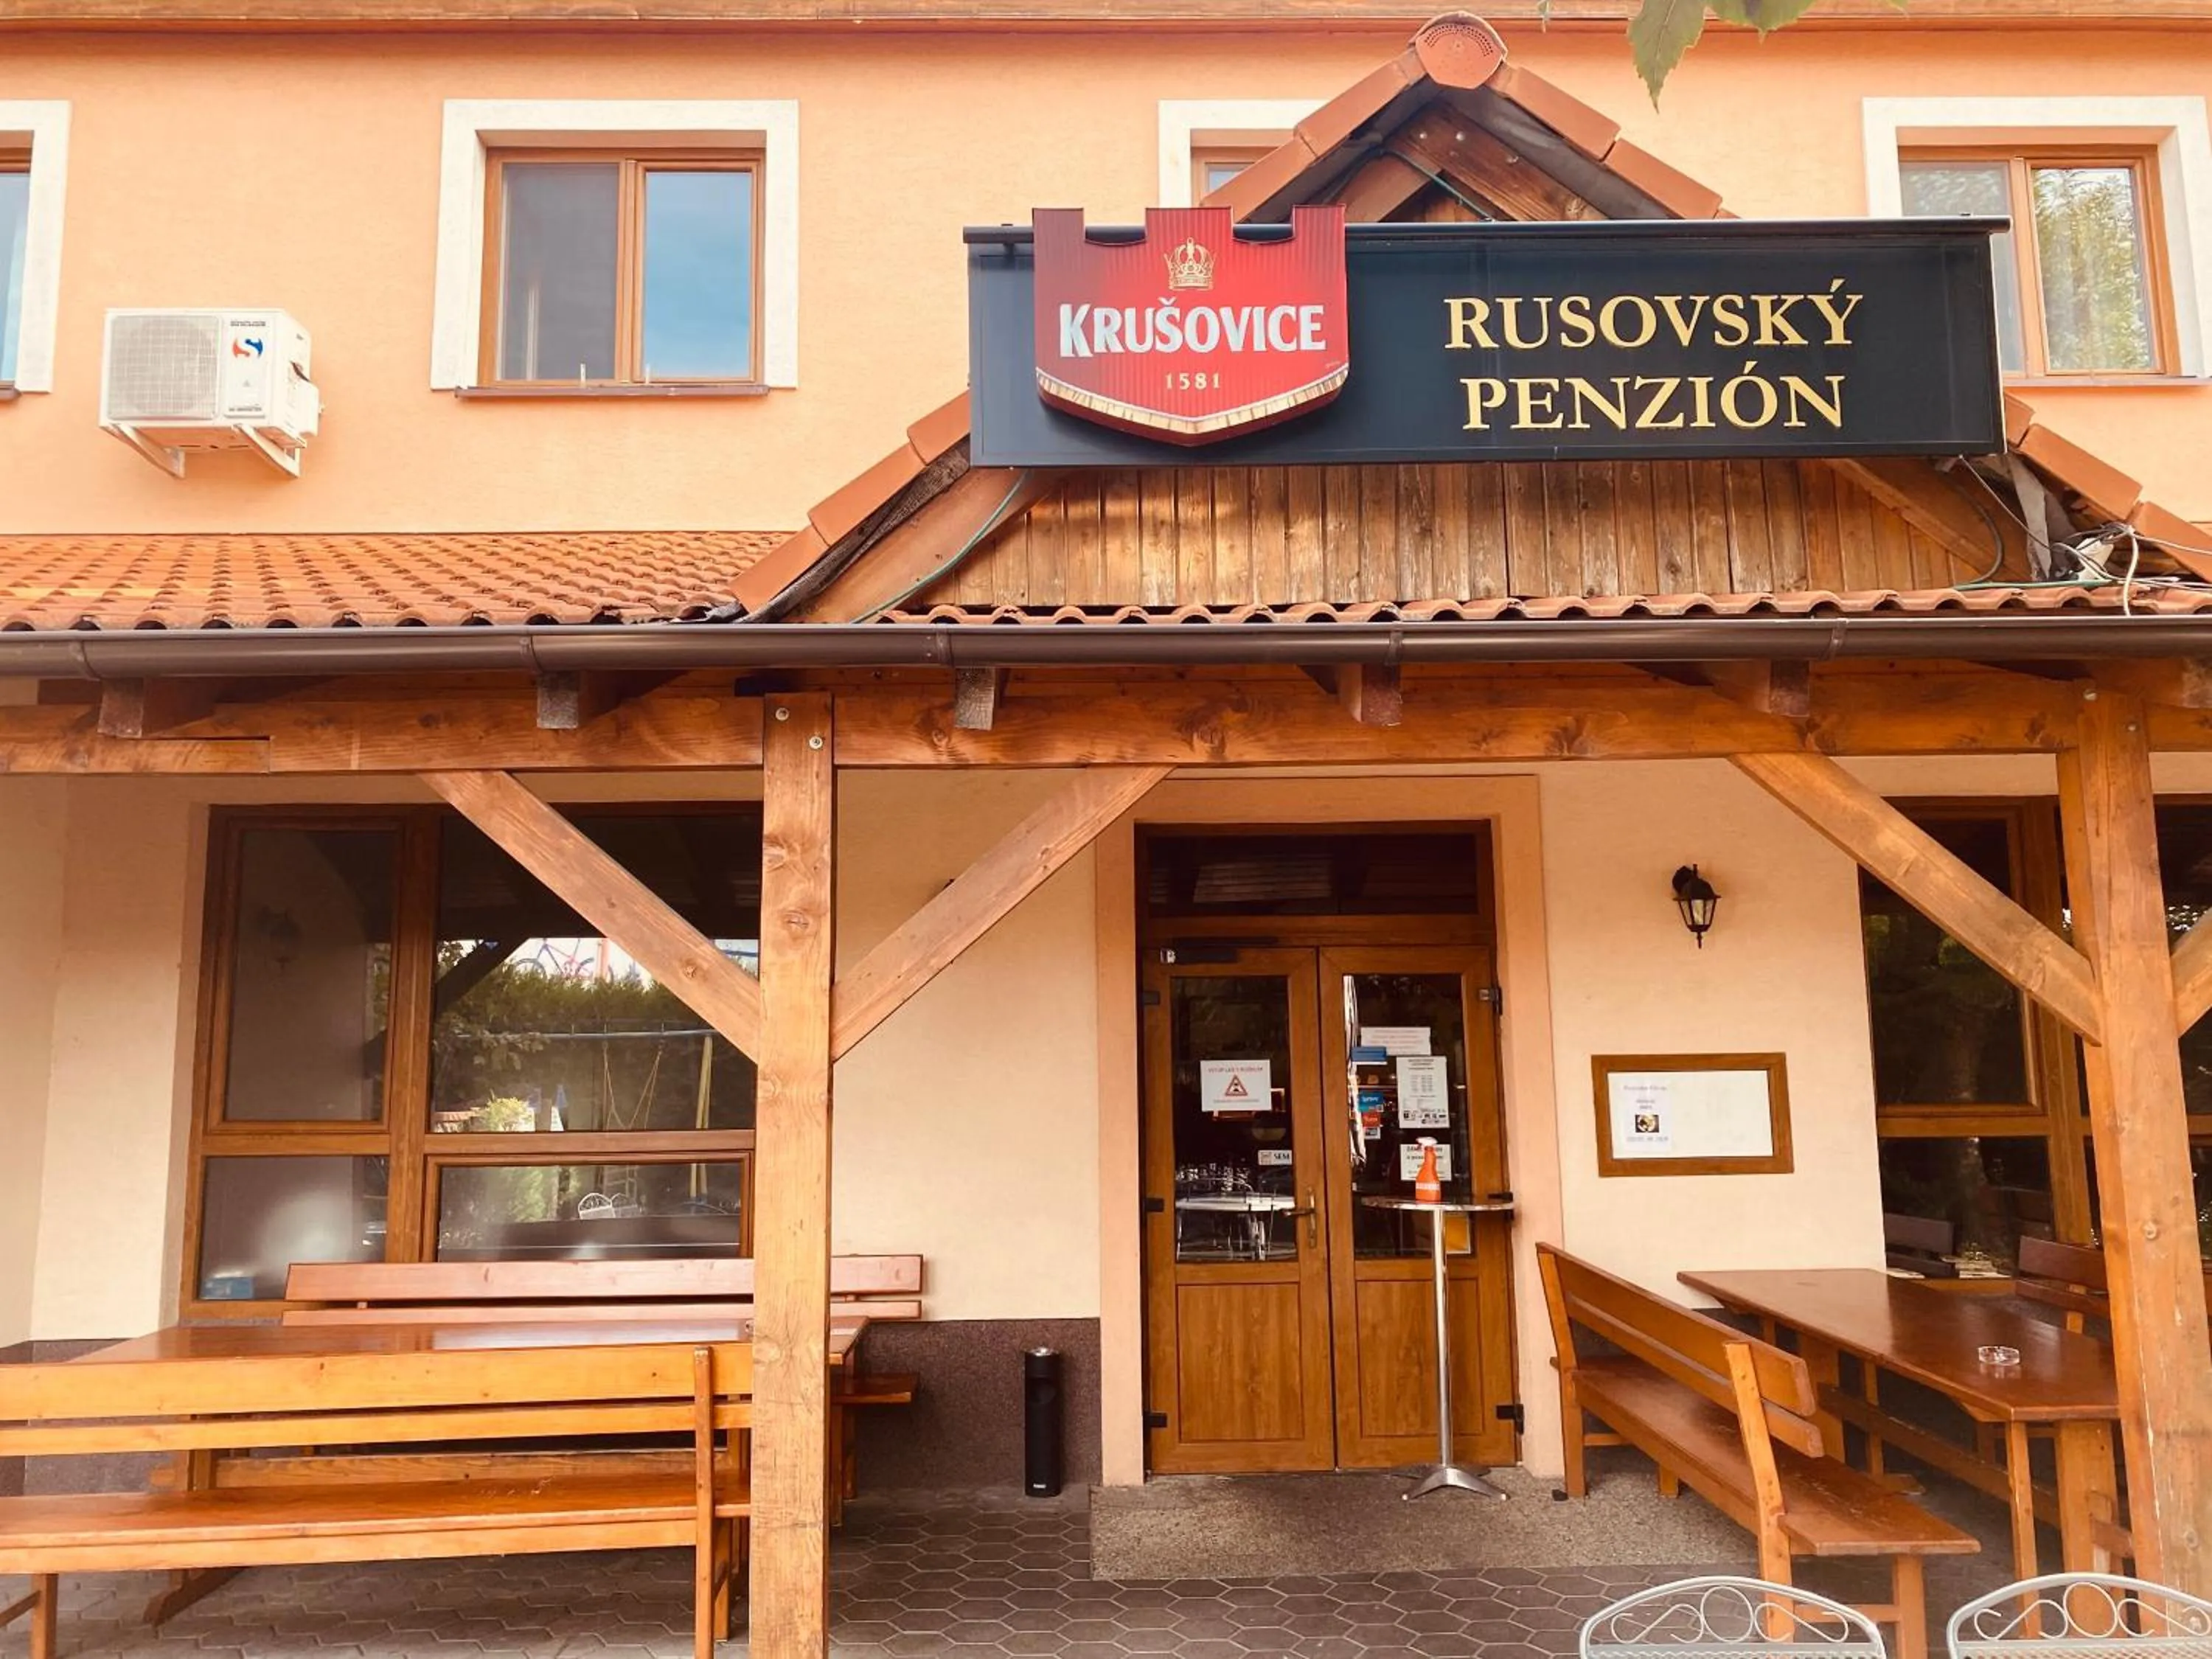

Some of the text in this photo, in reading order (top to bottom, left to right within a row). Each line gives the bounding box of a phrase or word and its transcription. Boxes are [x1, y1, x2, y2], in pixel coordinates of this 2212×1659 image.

[1059, 296, 1327, 358] KRUŠOVICE
[1443, 278, 1863, 349] RUSOVSKÝ
[1165, 373, 1221, 391] 1581
[1459, 361, 1846, 430] PENZIÓN
